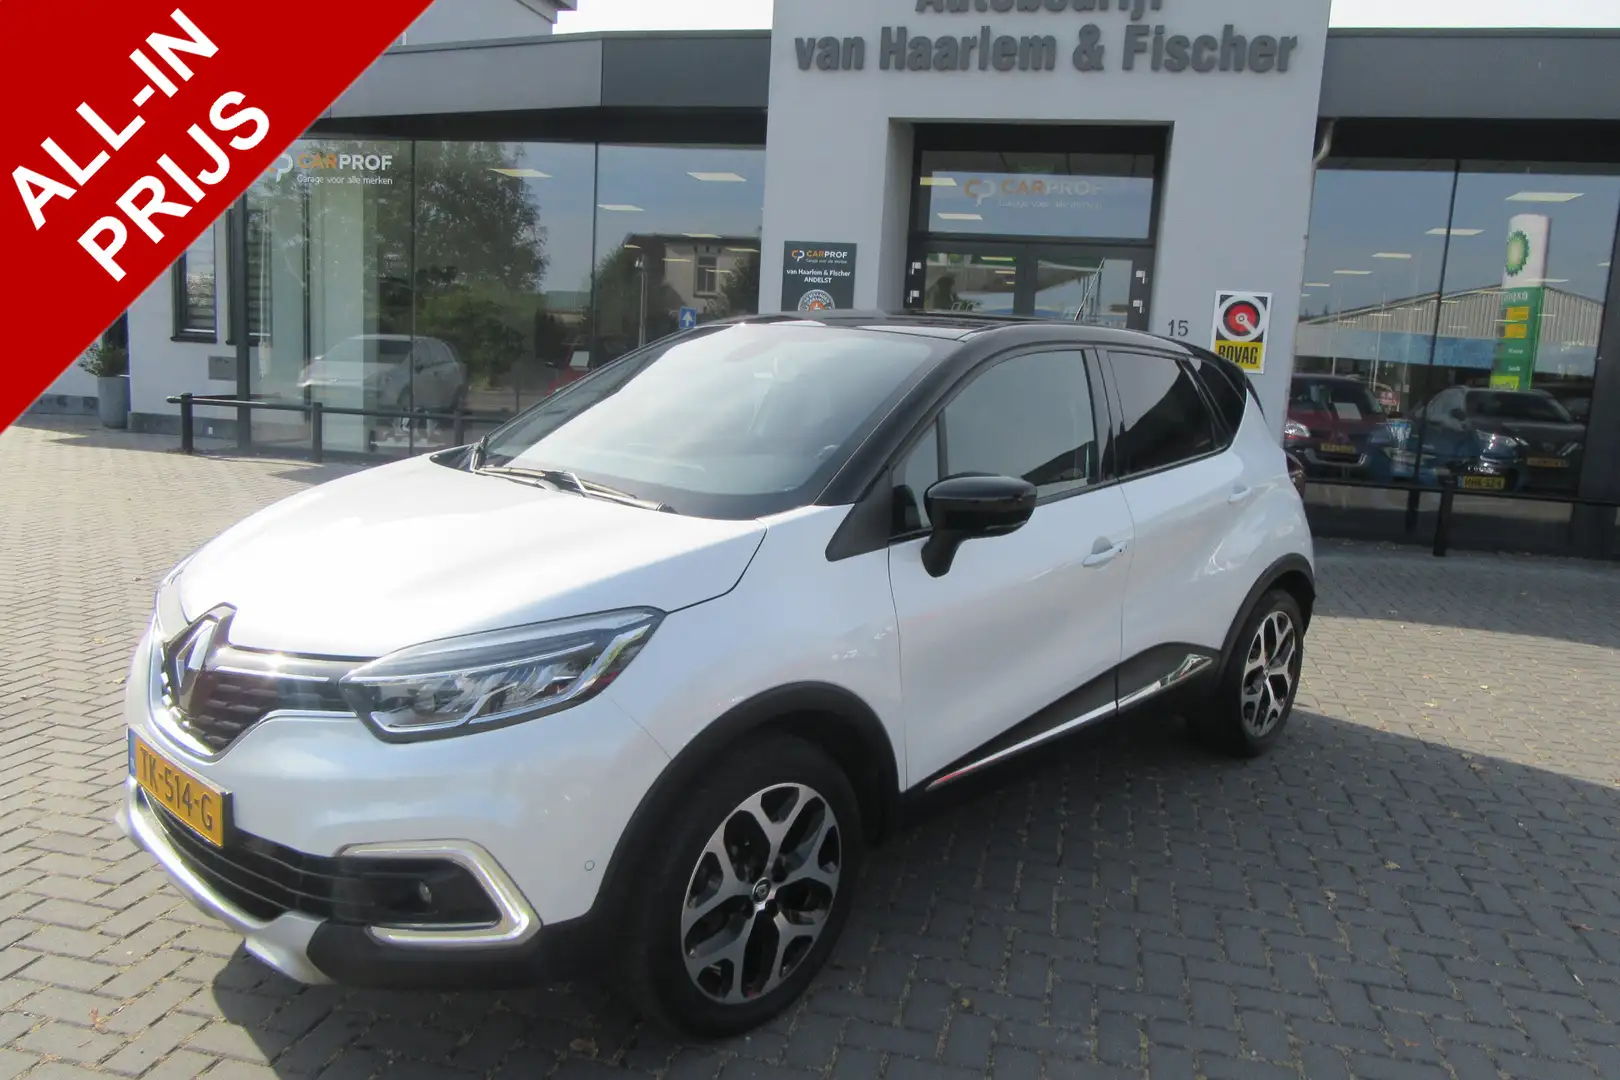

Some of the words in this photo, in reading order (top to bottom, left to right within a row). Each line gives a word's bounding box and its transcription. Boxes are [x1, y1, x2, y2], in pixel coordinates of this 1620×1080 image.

[794, 36, 866, 71] van
[879, 25, 1058, 72] Haarlem
[1072, 23, 1106, 72] &
[1122, 24, 1298, 73] Fischer
[297, 152, 393, 171] CARPROF
[296, 174, 325, 185] Garage
[327, 176, 344, 185] voor
[348, 175, 361, 185] alle
[363, 176, 393, 185] merken
[806, 250, 848, 259] CARPROF
[1168, 319, 1189, 337] 15
[140, 745, 213, 832] TK-514-G
